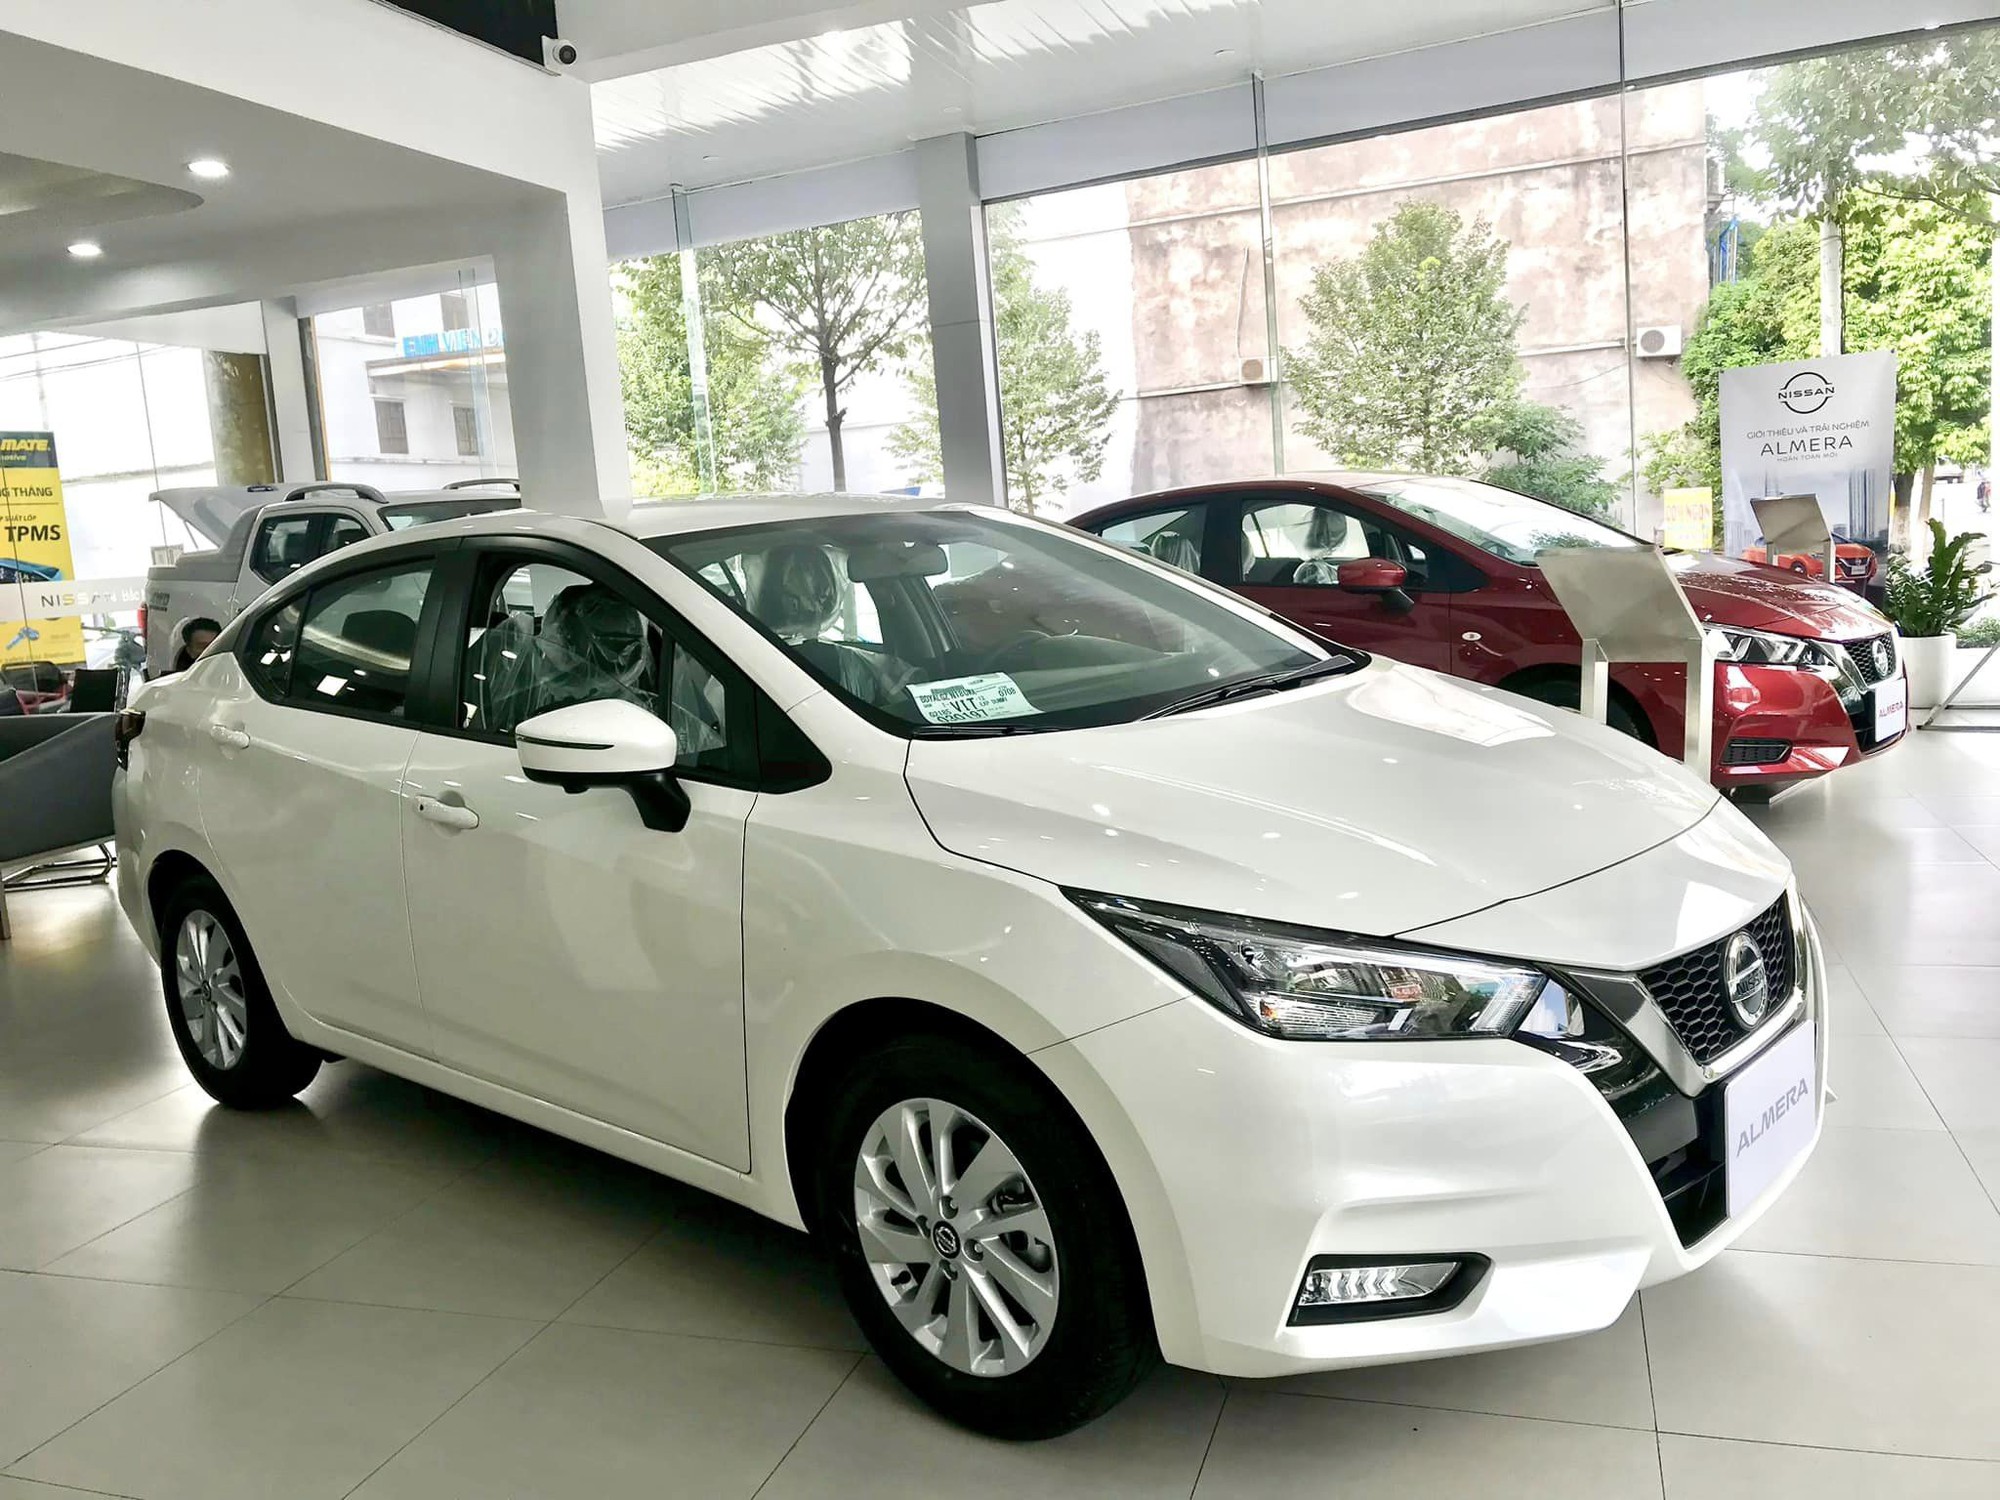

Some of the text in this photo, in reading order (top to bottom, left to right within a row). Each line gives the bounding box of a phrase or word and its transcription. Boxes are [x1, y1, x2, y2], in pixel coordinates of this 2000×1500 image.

[1778, 386, 1835, 400] NISSAN
[1760, 435, 1853, 456] ALMERA
[4, 525, 61, 542] TPMS
[1736, 1077, 1809, 1158] ALMERA
